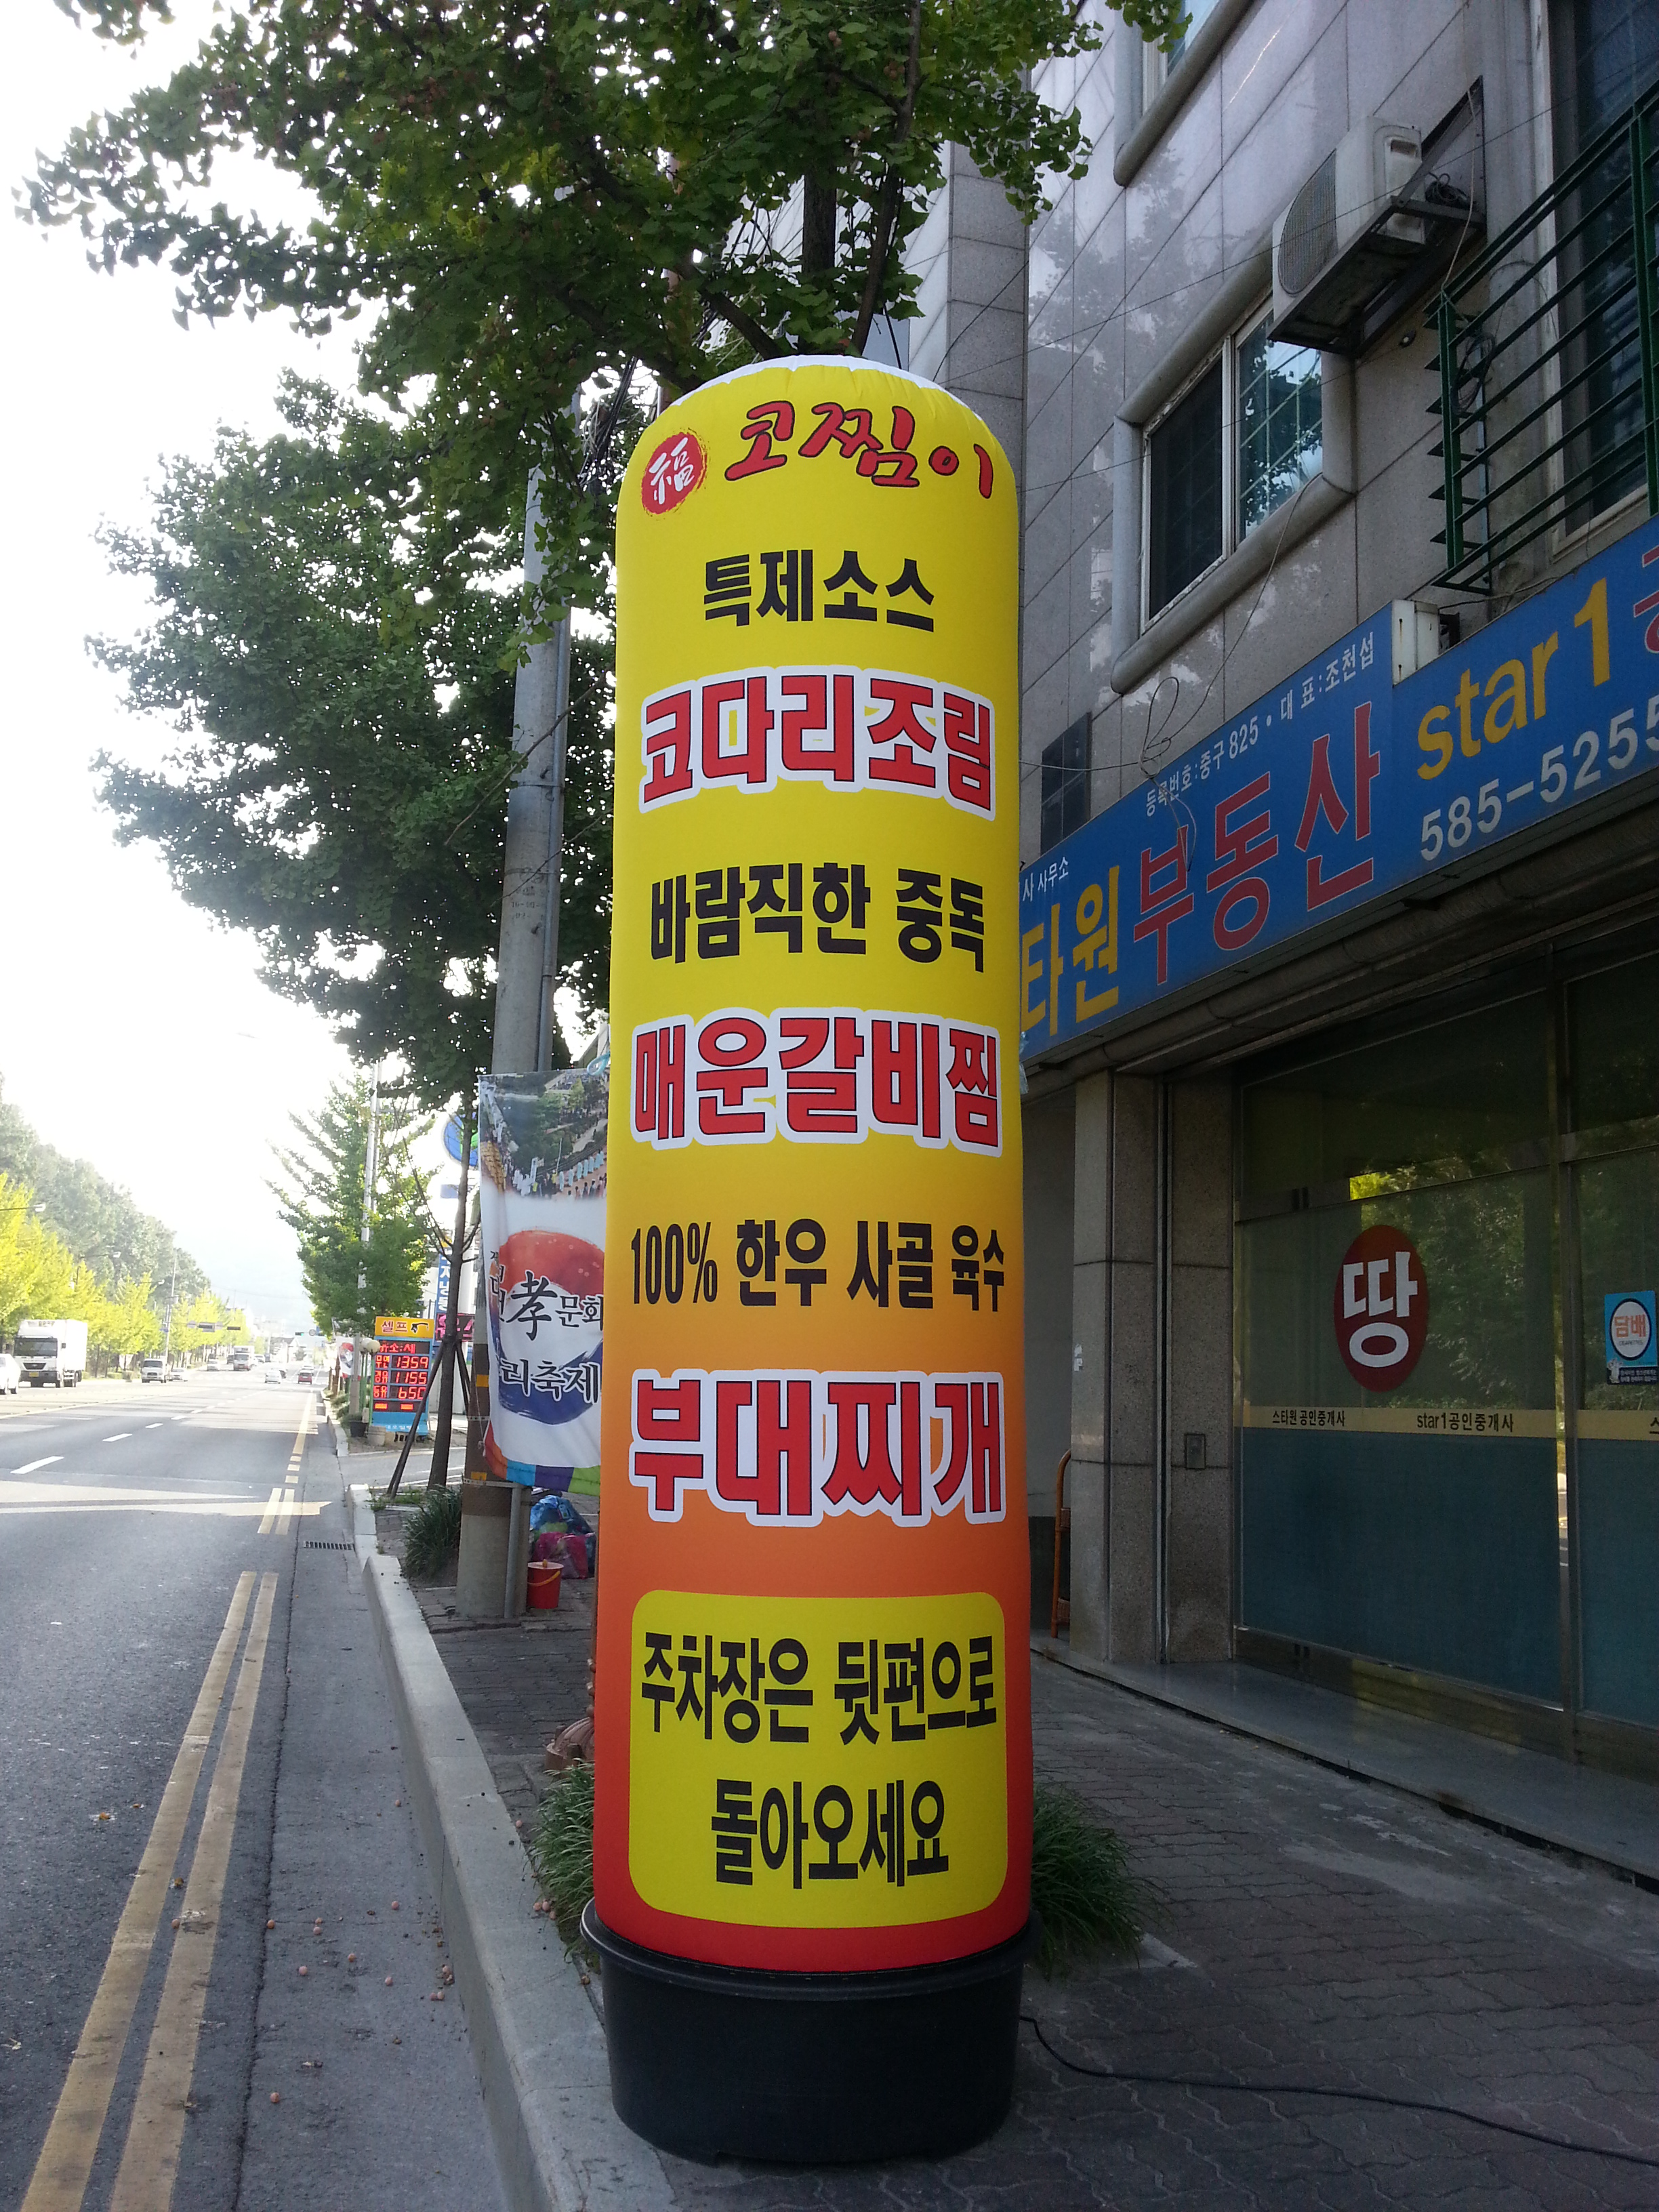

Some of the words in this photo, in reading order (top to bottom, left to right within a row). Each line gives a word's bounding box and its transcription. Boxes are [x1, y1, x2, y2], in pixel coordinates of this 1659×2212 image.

[724, 401, 994, 499] 코찜이
[703, 549, 935, 633] 특제소스
[642, 673, 992, 813] 코다리조림
[1229, 715, 1259, 760] 825
[1037, 856, 1069, 893] 사무소
[1133, 701, 1381, 986] 부동산
[651, 862, 871, 964] 바람직한
[895, 868, 985, 973] 중독
[634, 1017, 999, 1148] 매운갈비찜
[630, 1221, 718, 1305] 100%
[736, 1218, 827, 1307] 한우
[846, 1221, 934, 1309] 사골
[951, 1224, 1004, 1312] 육수
[1343, 1251, 1418, 1368] 땅
[382, 1320, 408, 1334] 셀프
[396, 1355, 429, 1369] 1359
[1614, 1313, 1647, 1338] 담배
[395, 1371, 428, 1385] 1155
[499, 1358, 600, 1404] 리축제
[633, 1379, 1002, 1516] 부대찌개
[641, 1631, 813, 1744] 주차장은
[834, 1635, 997, 1746] 뒷편으로
[711, 1778, 949, 1889] 돌아오세요
